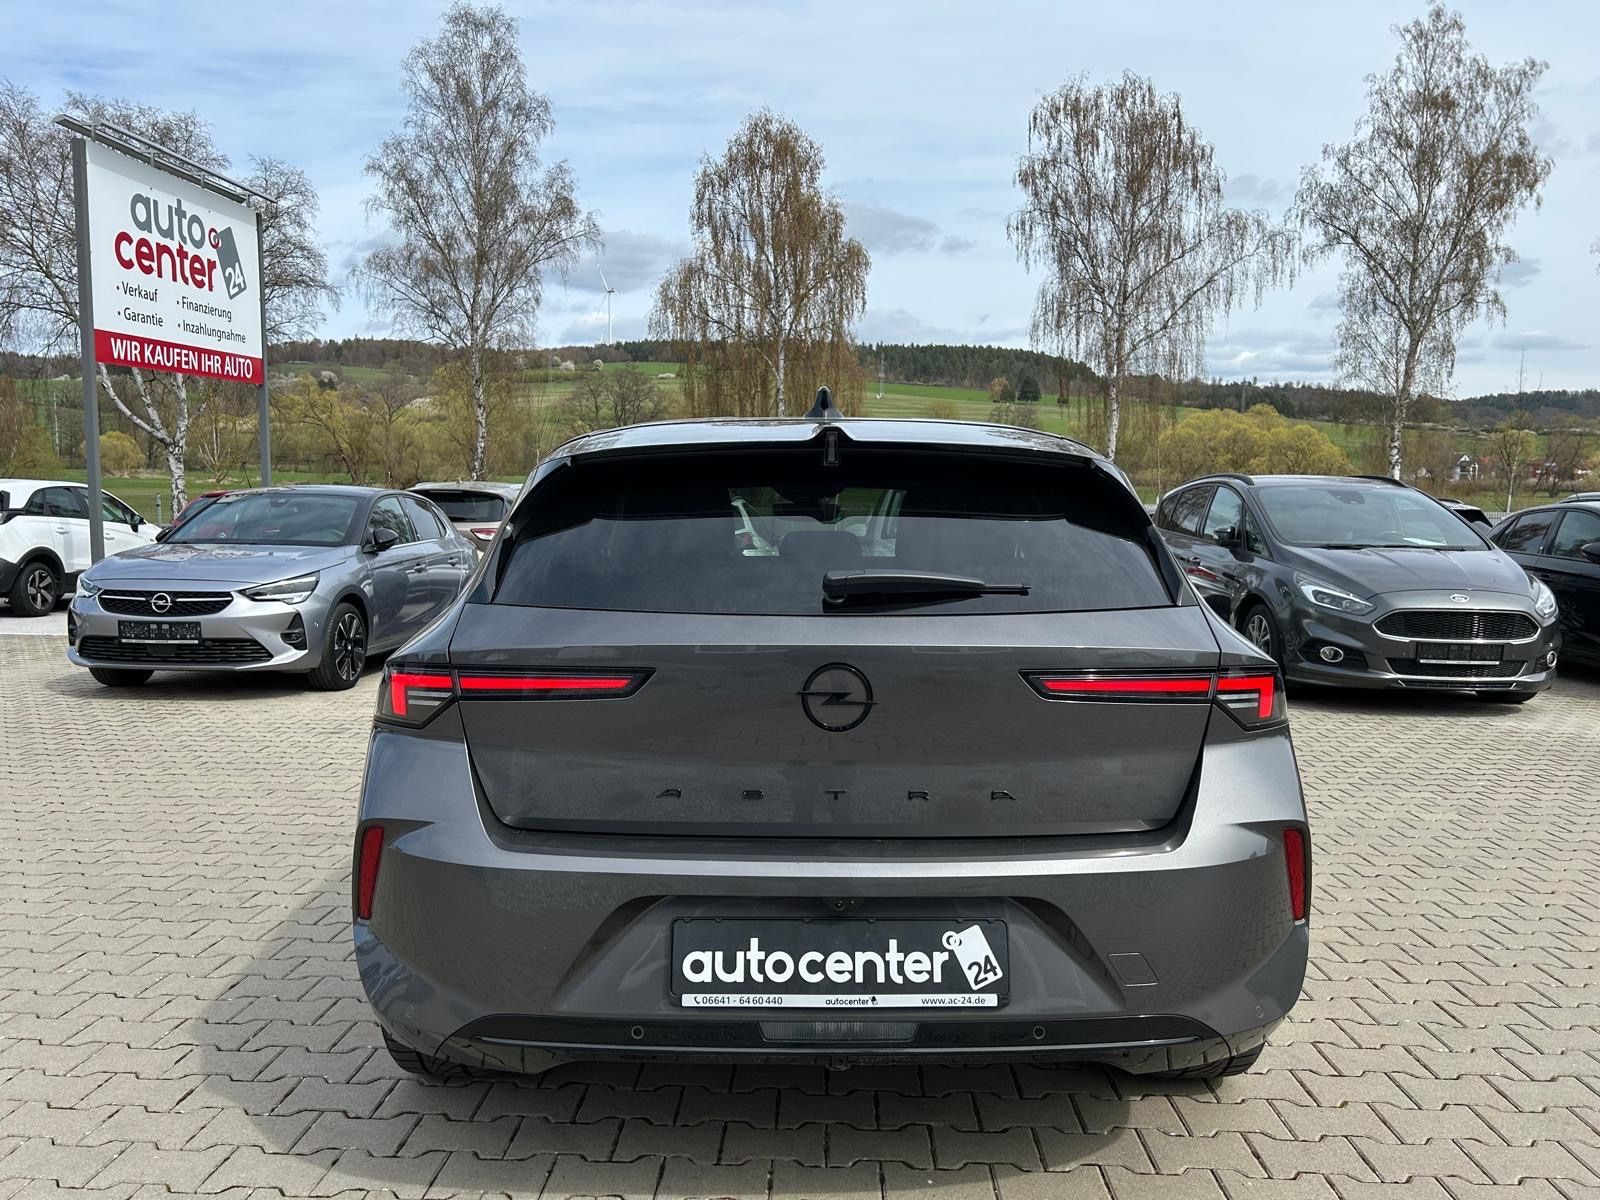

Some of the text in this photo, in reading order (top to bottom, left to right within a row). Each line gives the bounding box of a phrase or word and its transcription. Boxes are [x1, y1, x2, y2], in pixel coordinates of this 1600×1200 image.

[130, 193, 206, 249] auto
[114, 231, 217, 292] center
[225, 262, 245, 296] 24
[121, 281, 158, 303] Verkauf
[123, 307, 163, 327] Garantie
[181, 296, 232, 323] Finanzierung
[183, 320, 246, 344] Inzahlungnahme
[110, 337, 253, 379] WIR KAUFEN IHR AUTO
[967, 954, 998, 985] 24
[702, 996, 731, 1005] 06641
[825, 998, 869, 1006] autocenter
[921, 996, 986, 1005] www.ac-24.de
